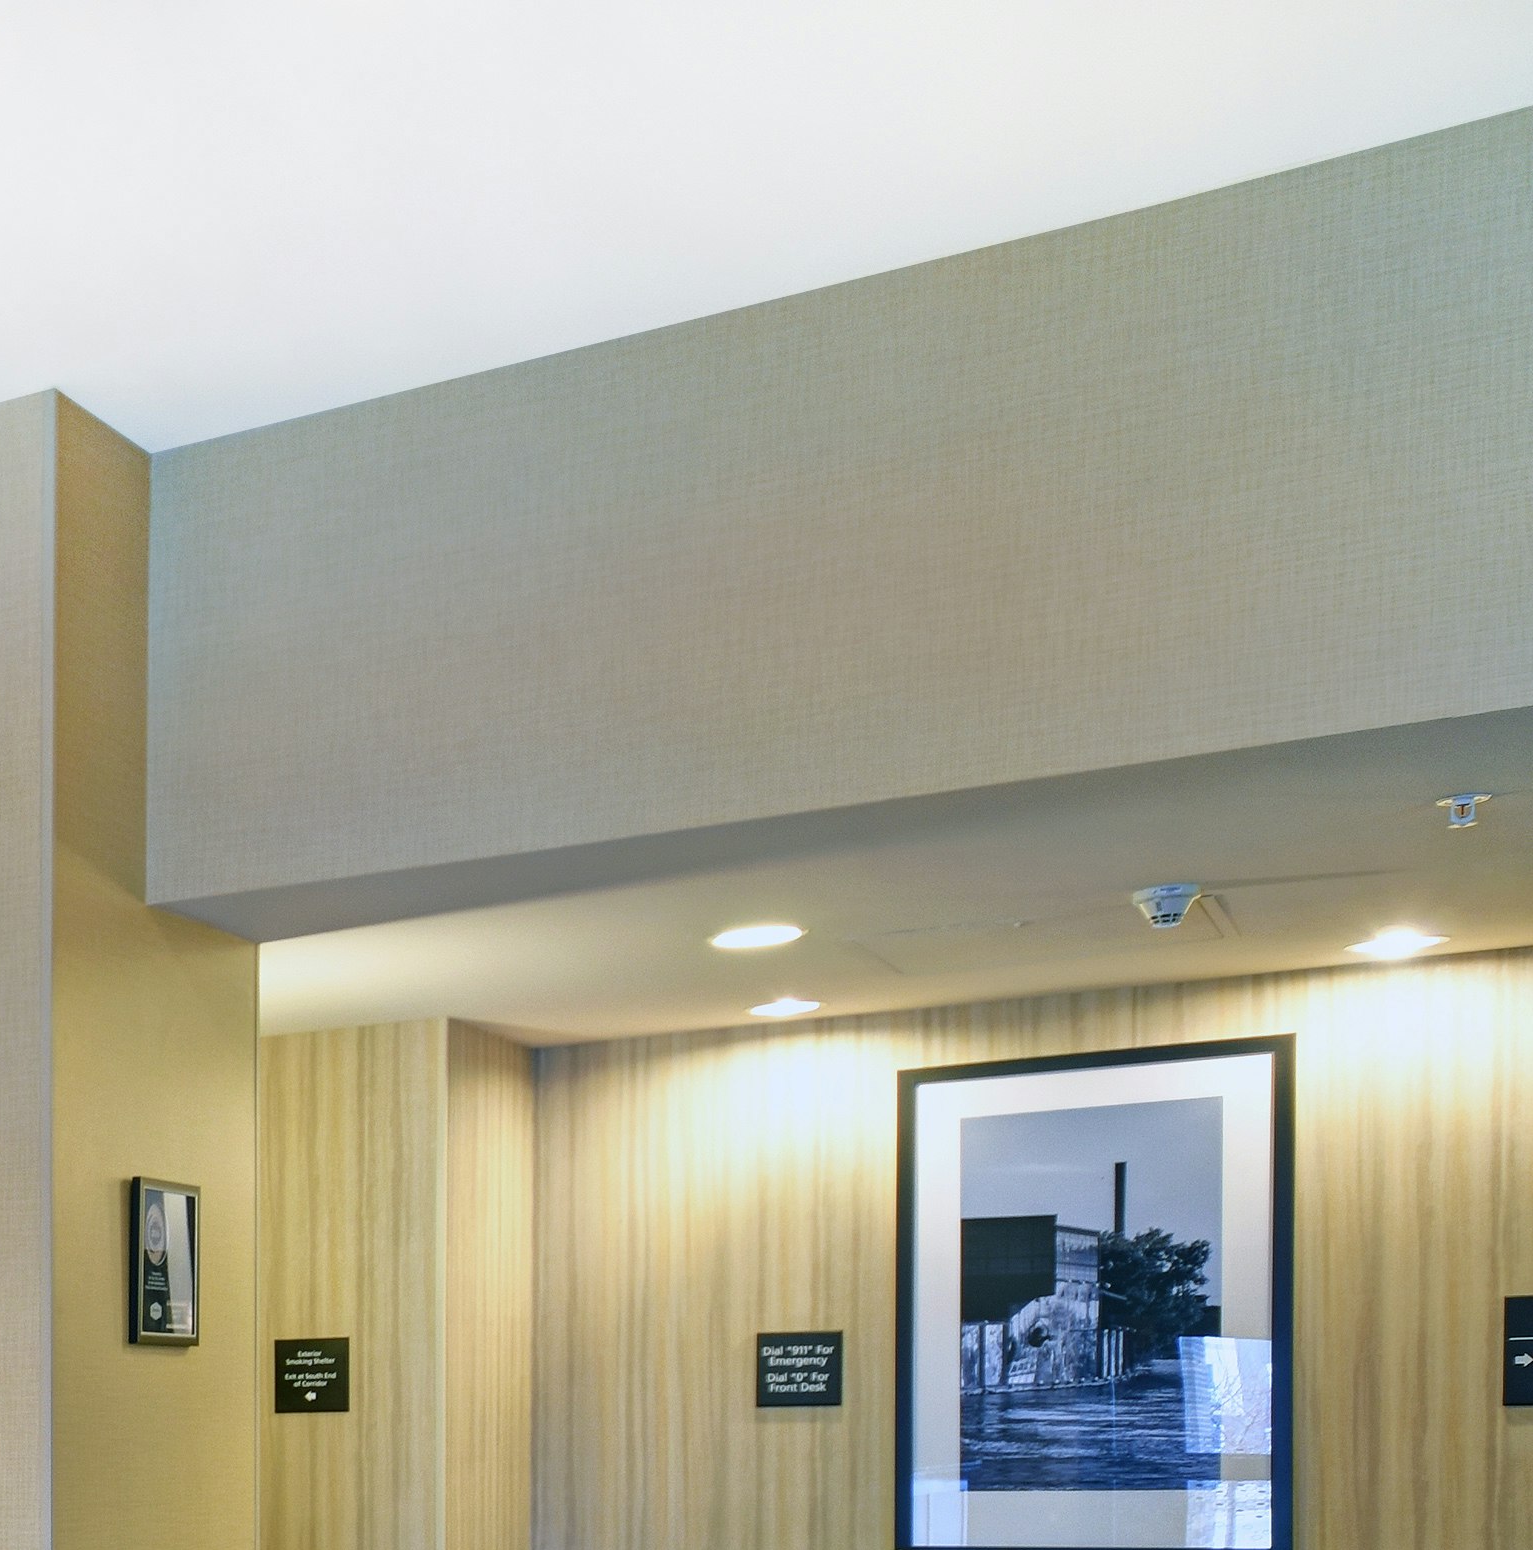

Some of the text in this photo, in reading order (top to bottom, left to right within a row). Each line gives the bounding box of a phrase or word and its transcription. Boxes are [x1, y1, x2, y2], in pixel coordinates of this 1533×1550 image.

[763, 1346, 783, 1356] Dial
[816, 1345, 834, 1354] For
[769, 1357, 828, 1368] Emergency
[766, 1372, 787, 1382] Dial
[810, 1372, 830, 1382] For
[768, 1382, 827, 1393] Front Desk
